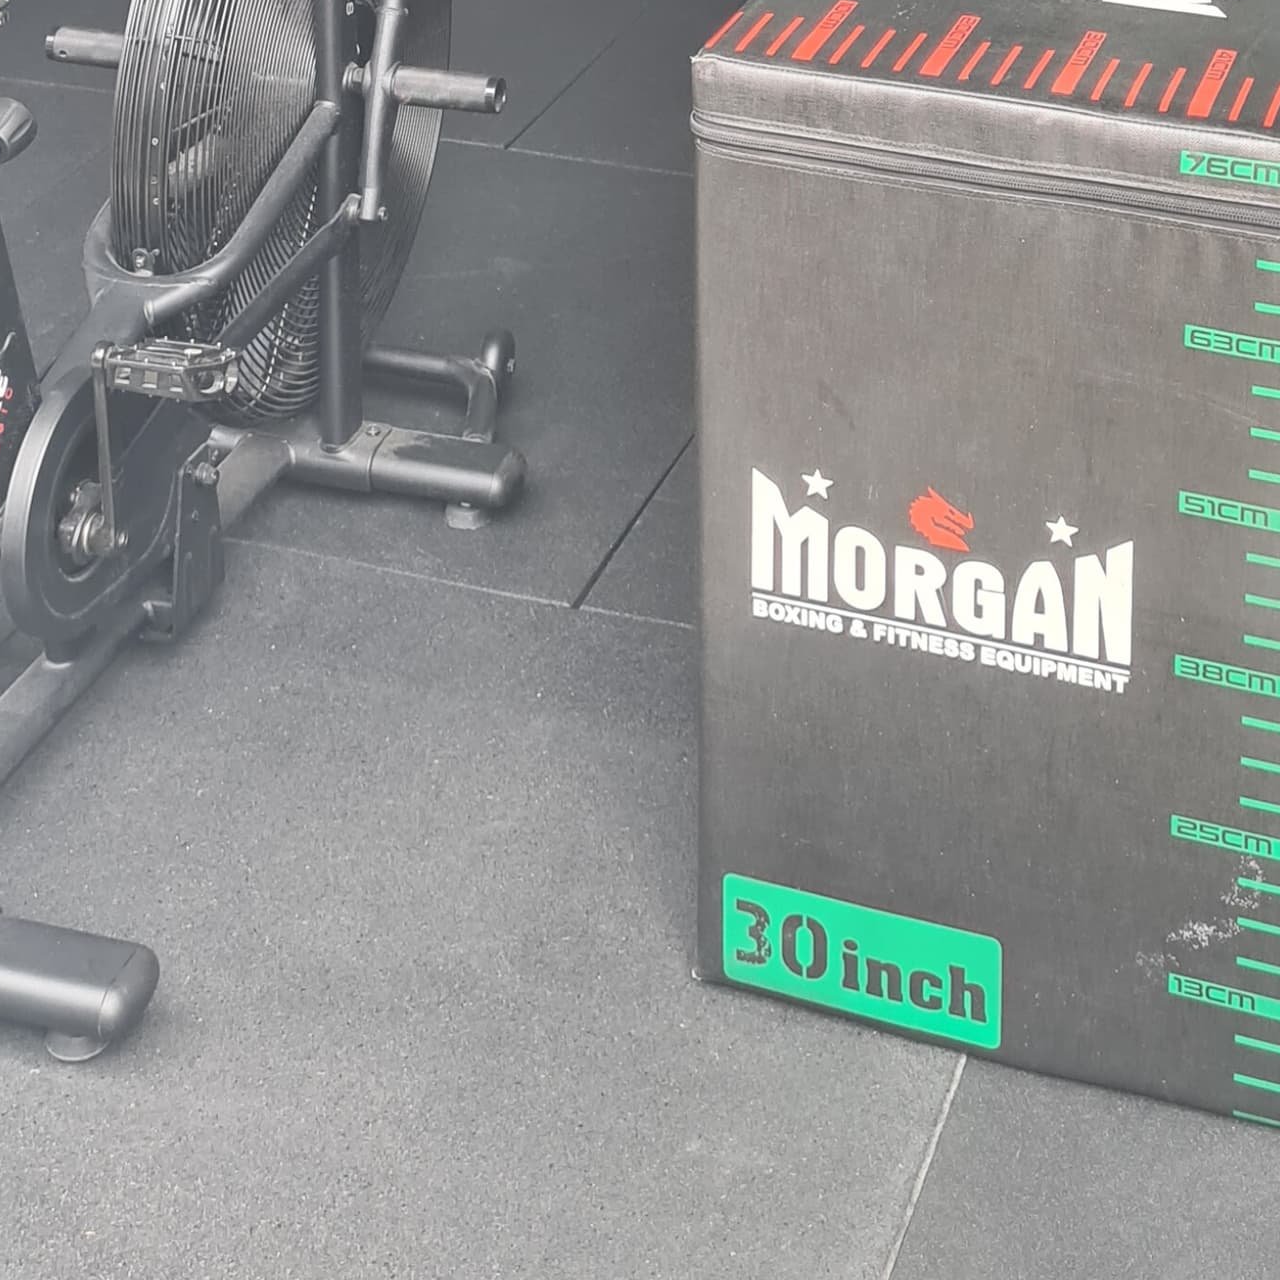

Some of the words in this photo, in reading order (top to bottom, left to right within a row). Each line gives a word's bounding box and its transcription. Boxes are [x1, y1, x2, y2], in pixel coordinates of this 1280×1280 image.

[751, 466, 1134, 666] MORGAN
[752, 597, 843, 634] BOXING
[850, 618, 868, 639] &
[873, 623, 976, 662] FITNESS
[980, 646, 1131, 695] EQUIPMENT
[735, 898, 829, 980] 30
[841, 939, 988, 1025] inch
